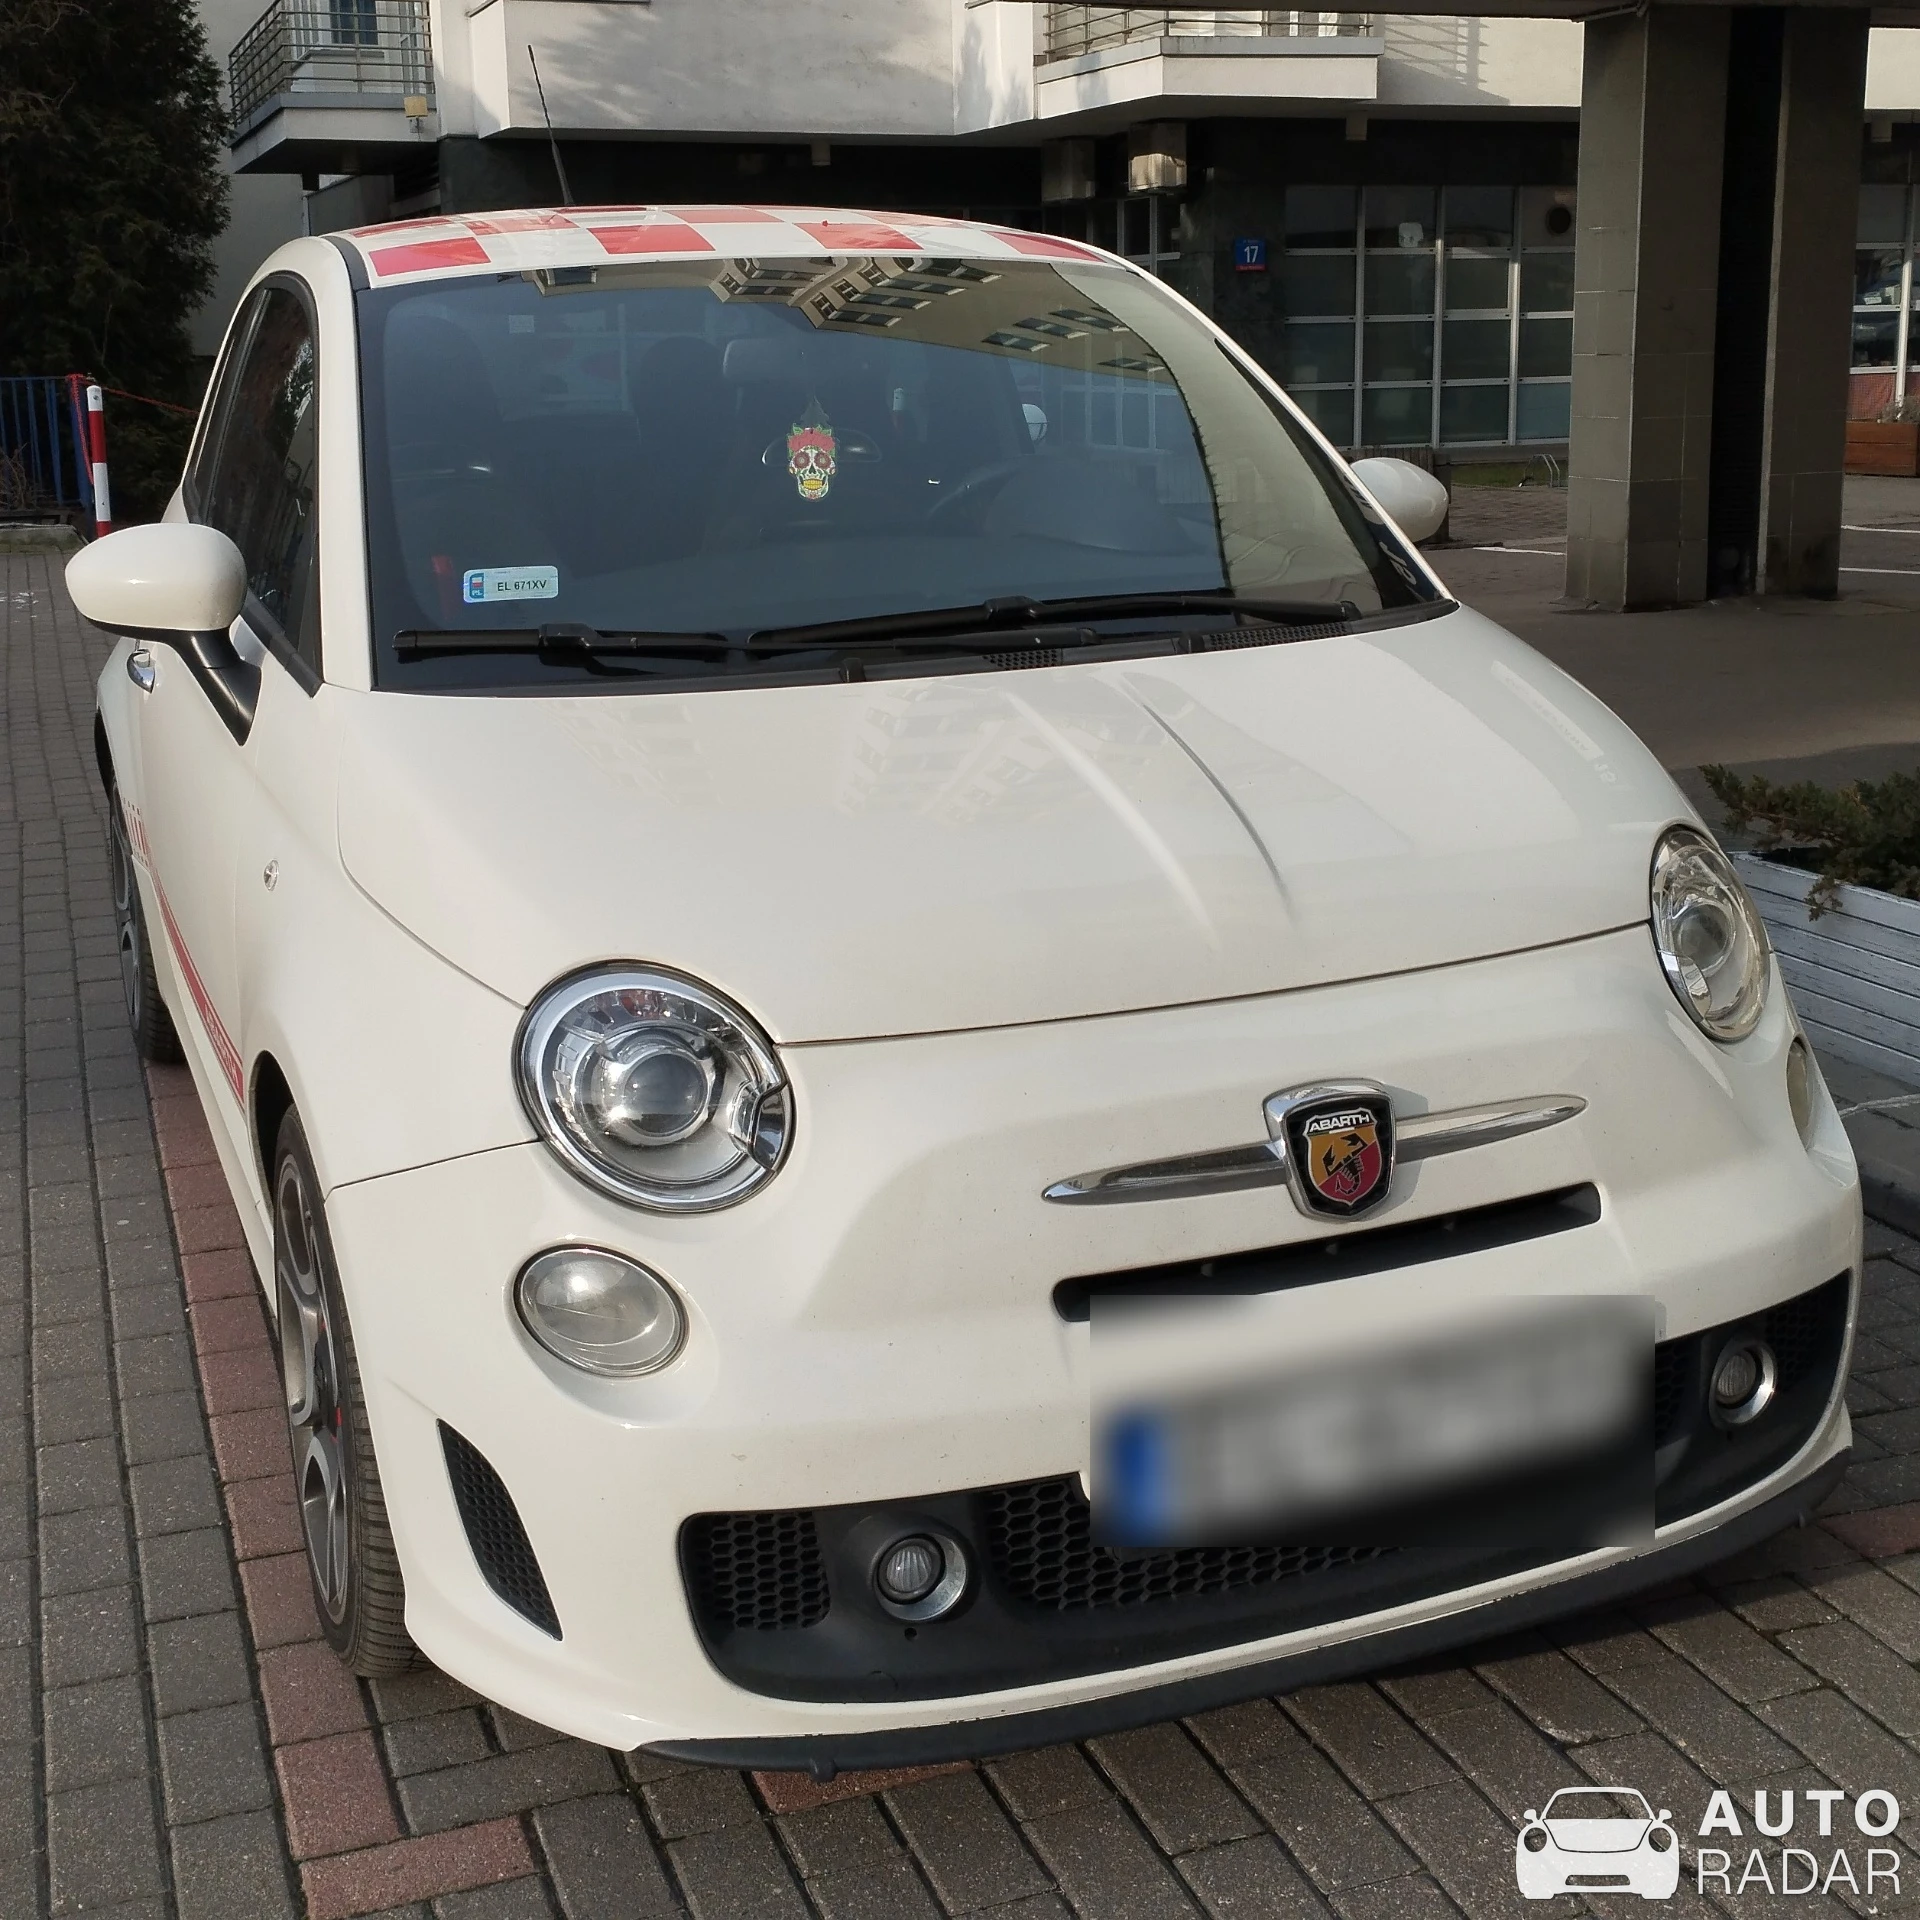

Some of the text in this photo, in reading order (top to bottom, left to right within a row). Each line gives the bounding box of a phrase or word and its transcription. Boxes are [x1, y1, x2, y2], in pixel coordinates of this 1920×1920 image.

[1244, 246, 1259, 263] 17
[497, 582, 511, 592] EL
[1309, 1114, 1370, 1132] ABARTH
